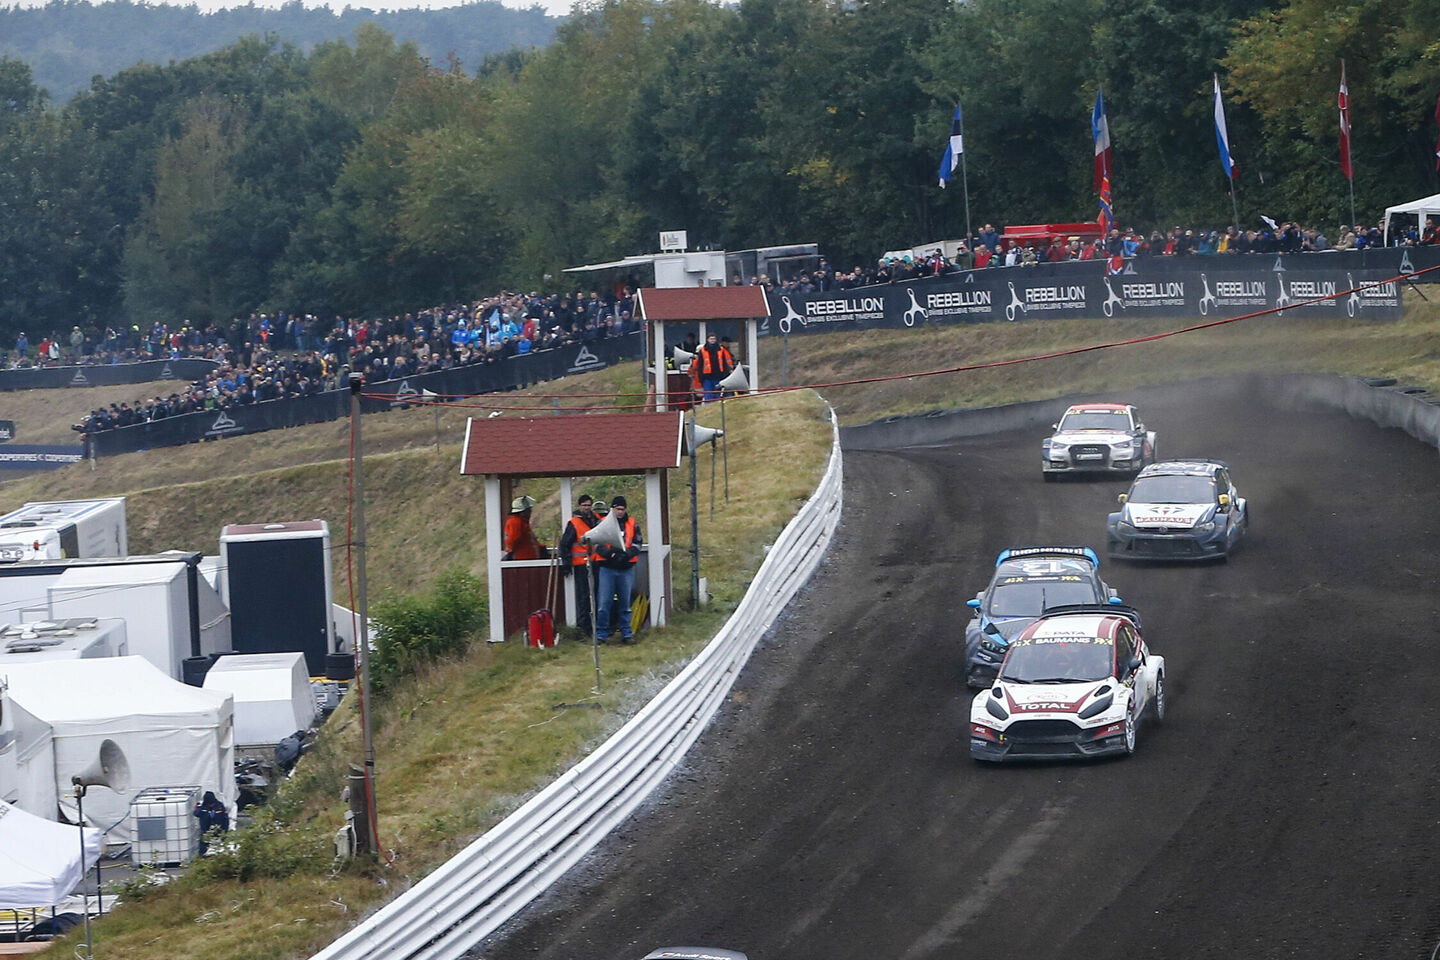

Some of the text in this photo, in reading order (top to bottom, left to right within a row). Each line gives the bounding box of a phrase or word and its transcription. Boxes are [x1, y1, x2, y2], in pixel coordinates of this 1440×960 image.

[1025, 286, 1086, 302] REBELLION
[1122, 282, 1184, 298] REBELLION
[1216, 281, 1266, 296] REBELLION
[1290, 282, 1336, 296] REBELLION
[1360, 281, 1397, 296] REBELLION
[805, 297, 884, 315] REBELLION
[927, 291, 991, 308] REBELLION
[1035, 637, 1091, 645] BAUMANIS
